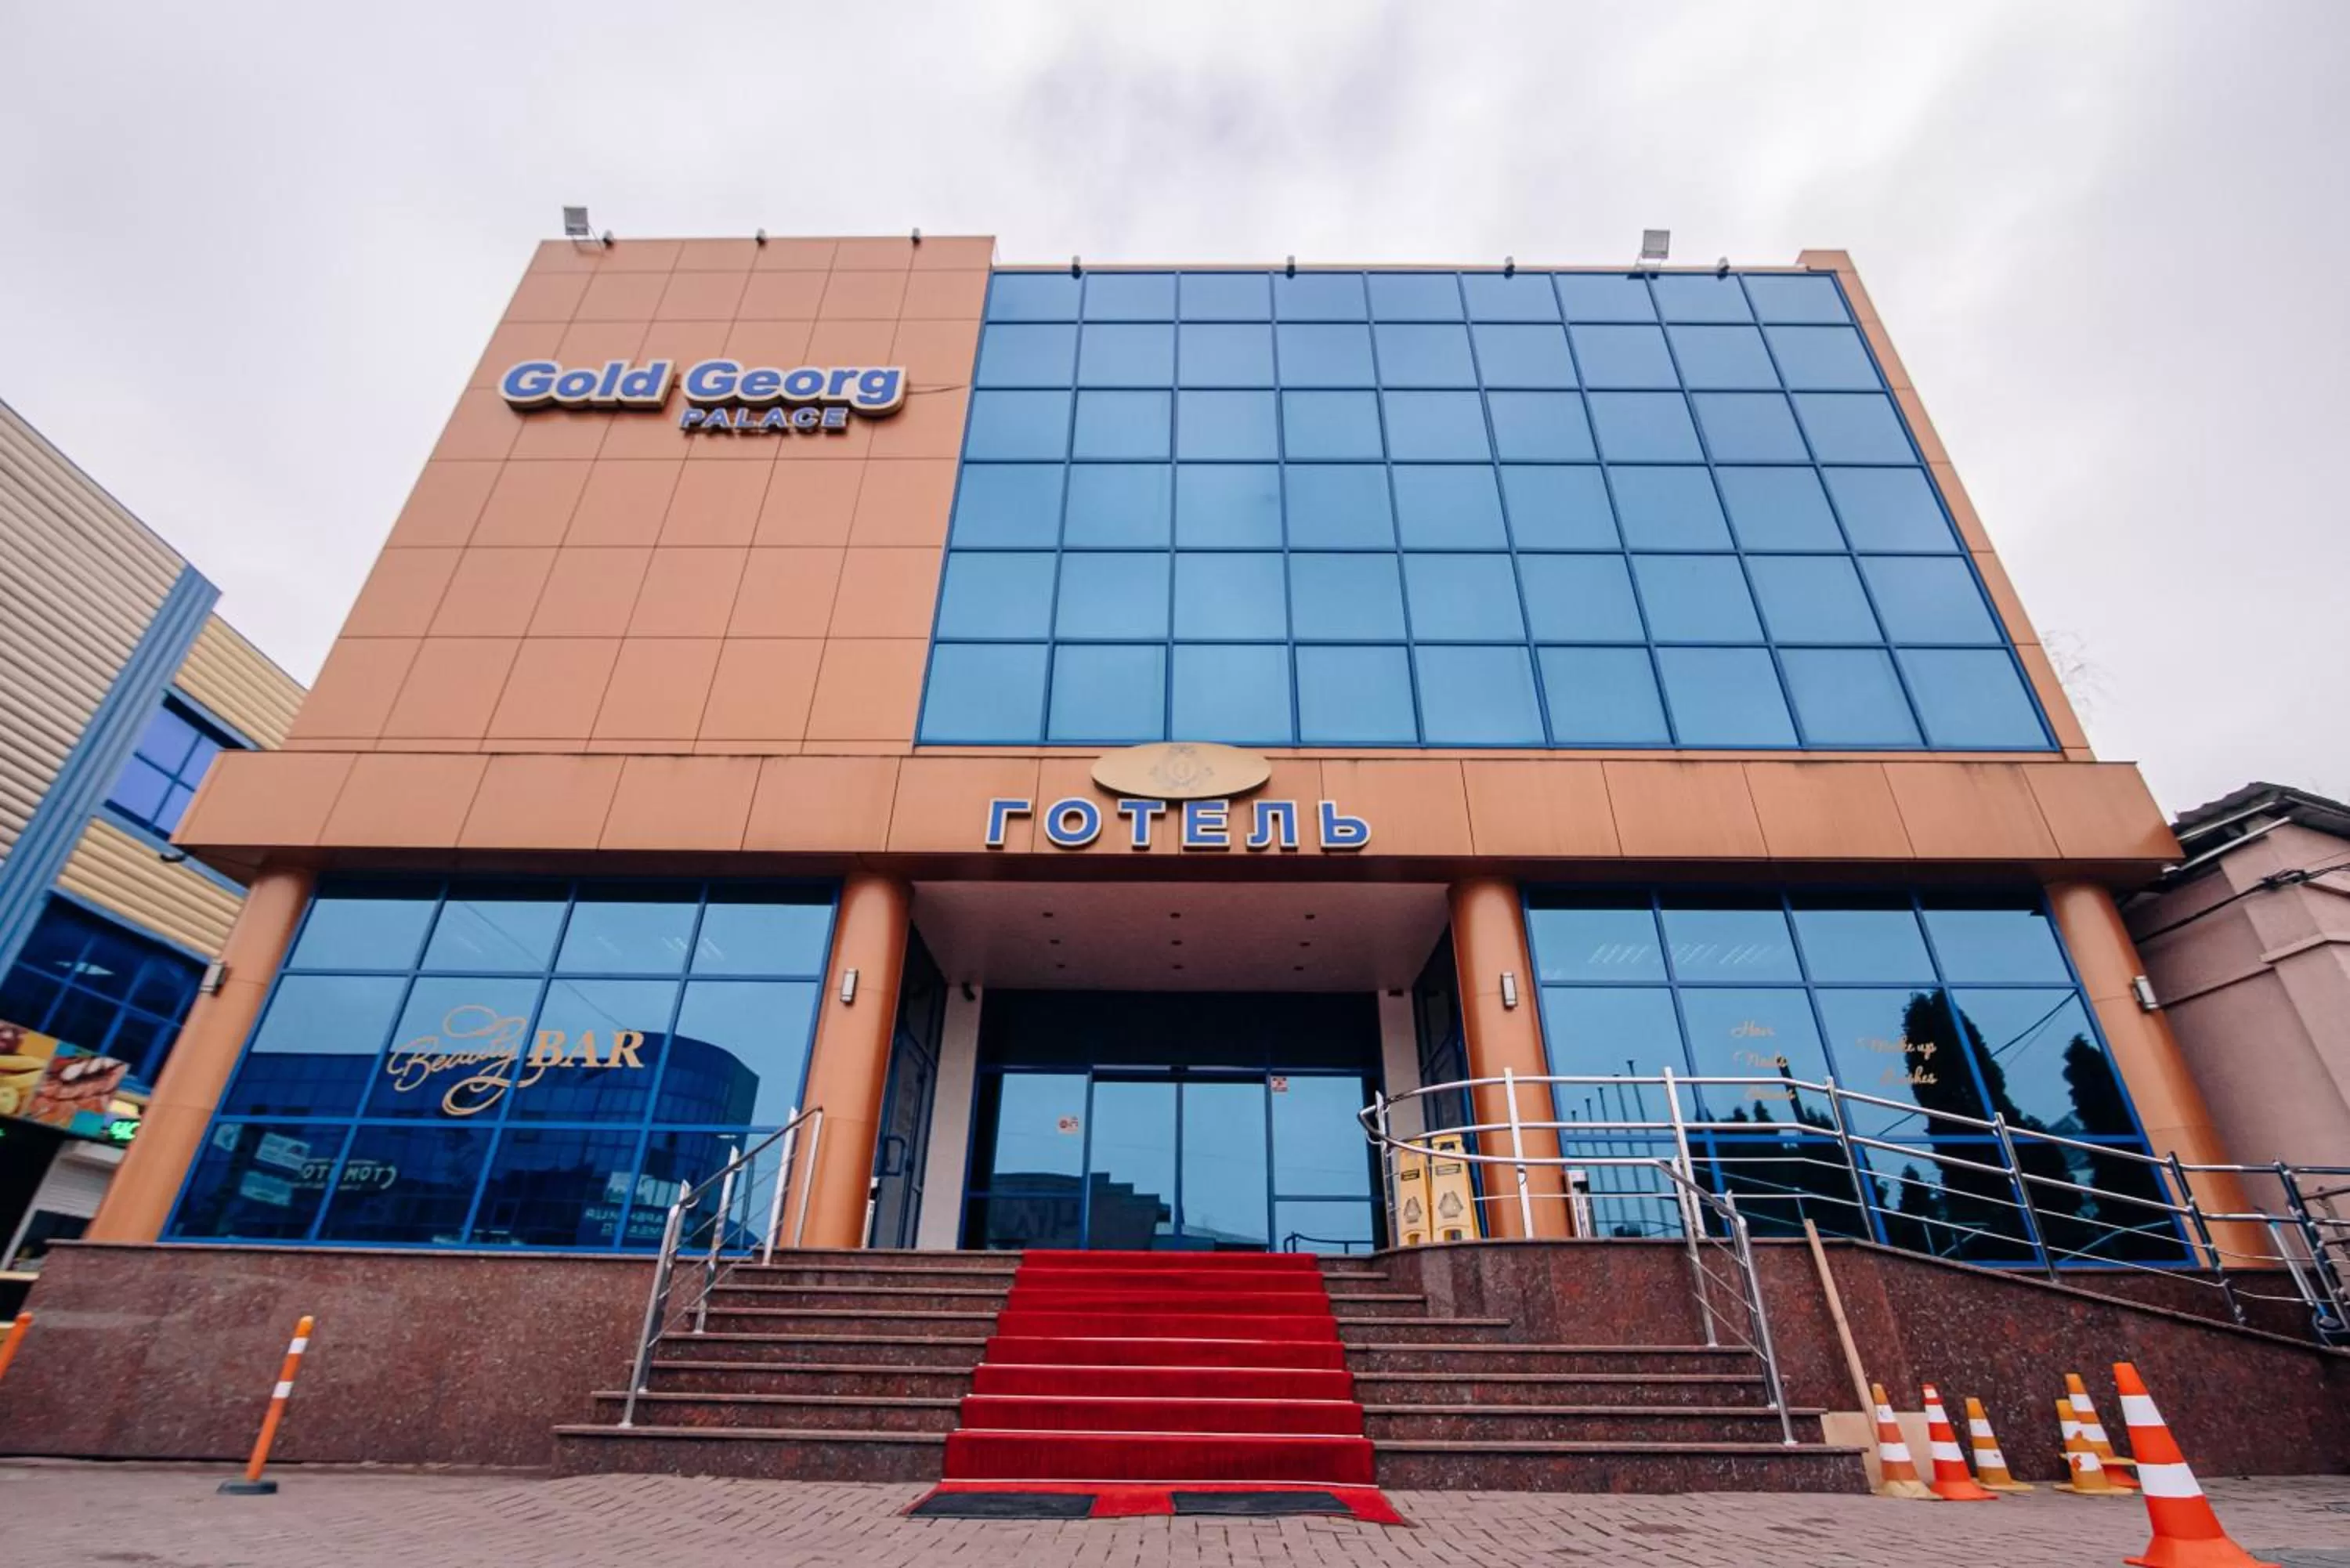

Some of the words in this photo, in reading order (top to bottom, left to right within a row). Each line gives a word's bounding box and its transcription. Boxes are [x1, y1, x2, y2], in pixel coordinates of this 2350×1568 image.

[499, 359, 674, 402] Gold
[683, 358, 908, 409] Georg
[679, 406, 851, 432] PALACE
[985, 797, 1371, 848] ГОТЕЛЬ
[526, 1029, 645, 1068] BAR
